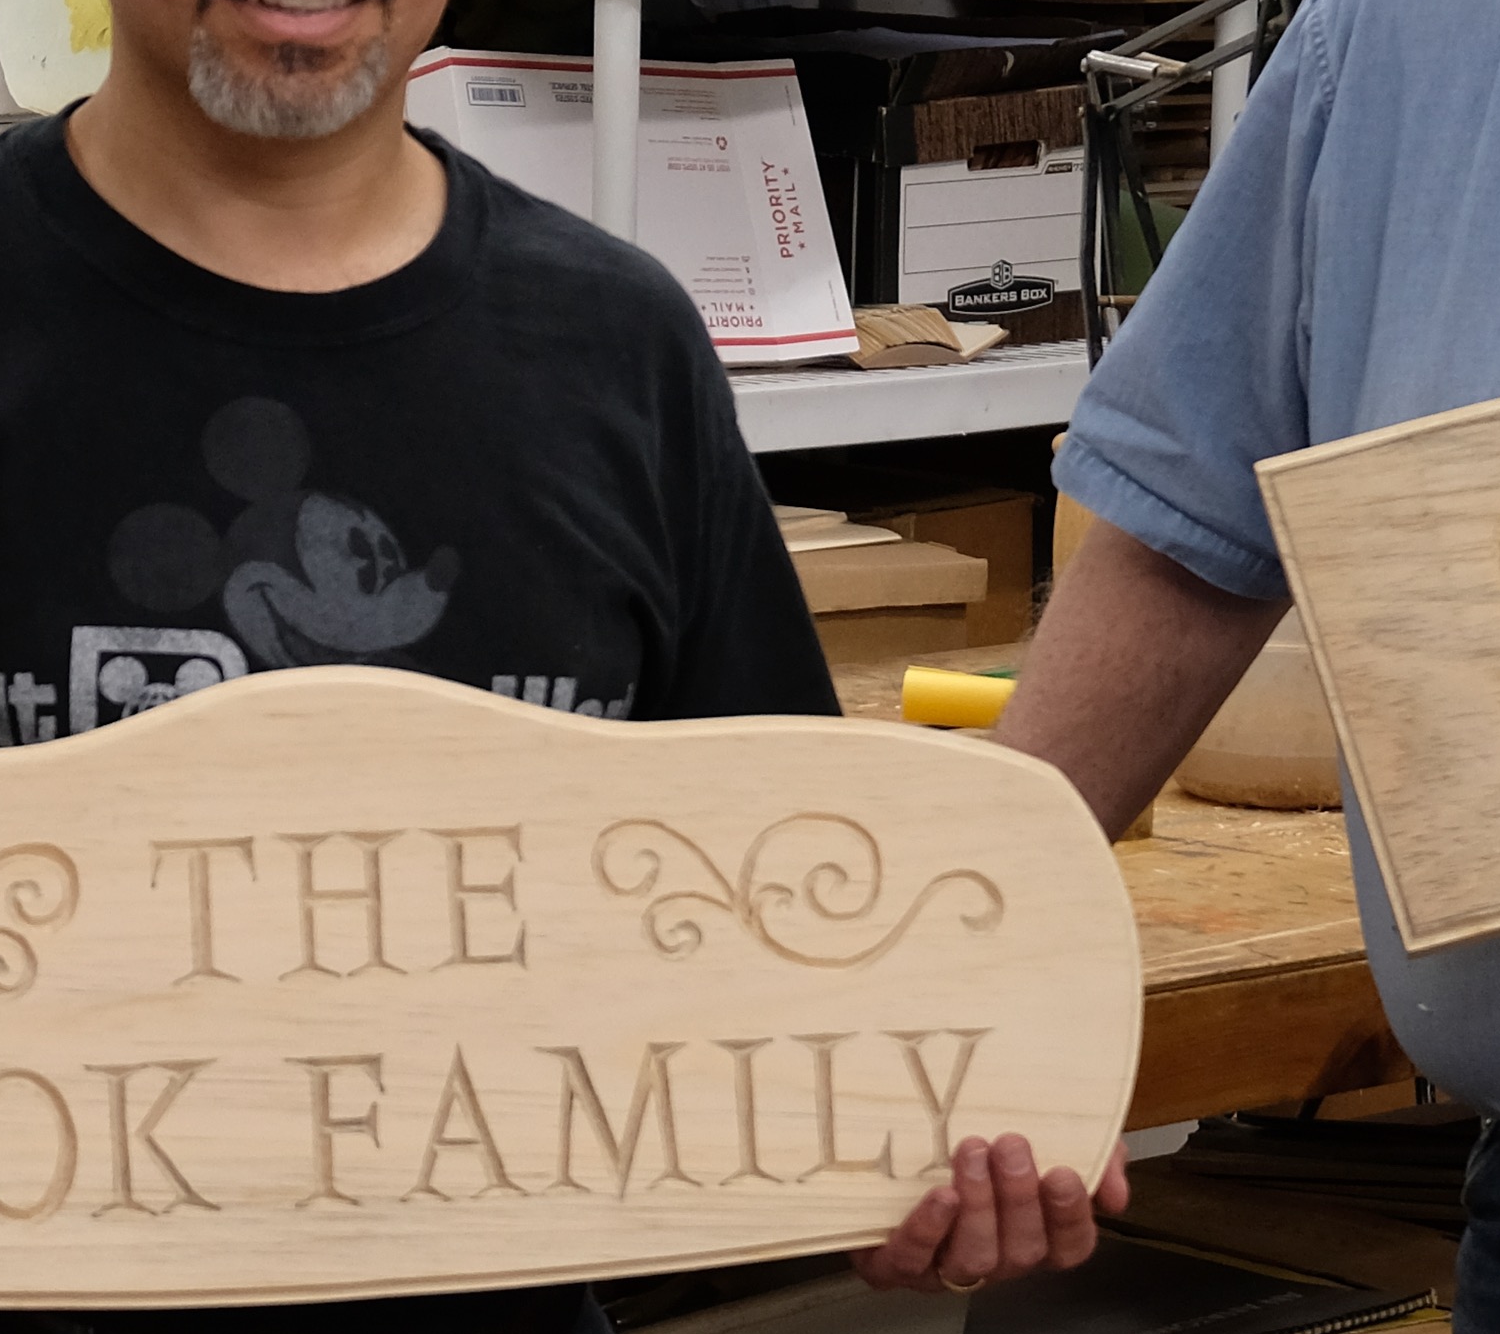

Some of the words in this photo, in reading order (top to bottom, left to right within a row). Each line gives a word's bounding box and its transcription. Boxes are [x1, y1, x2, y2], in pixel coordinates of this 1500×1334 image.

[761, 160, 794, 259] PRIORITY
[784, 182, 805, 234] MAIL
[706, 315, 763, 328] PRIORIT
[711, 301, 745, 311] MAIL
[955, 290, 1017, 307] BANKERS
[1020, 288, 1048, 301] BOX
[150, 821, 531, 988] THE
[284, 1024, 998, 1212] FAMILY
